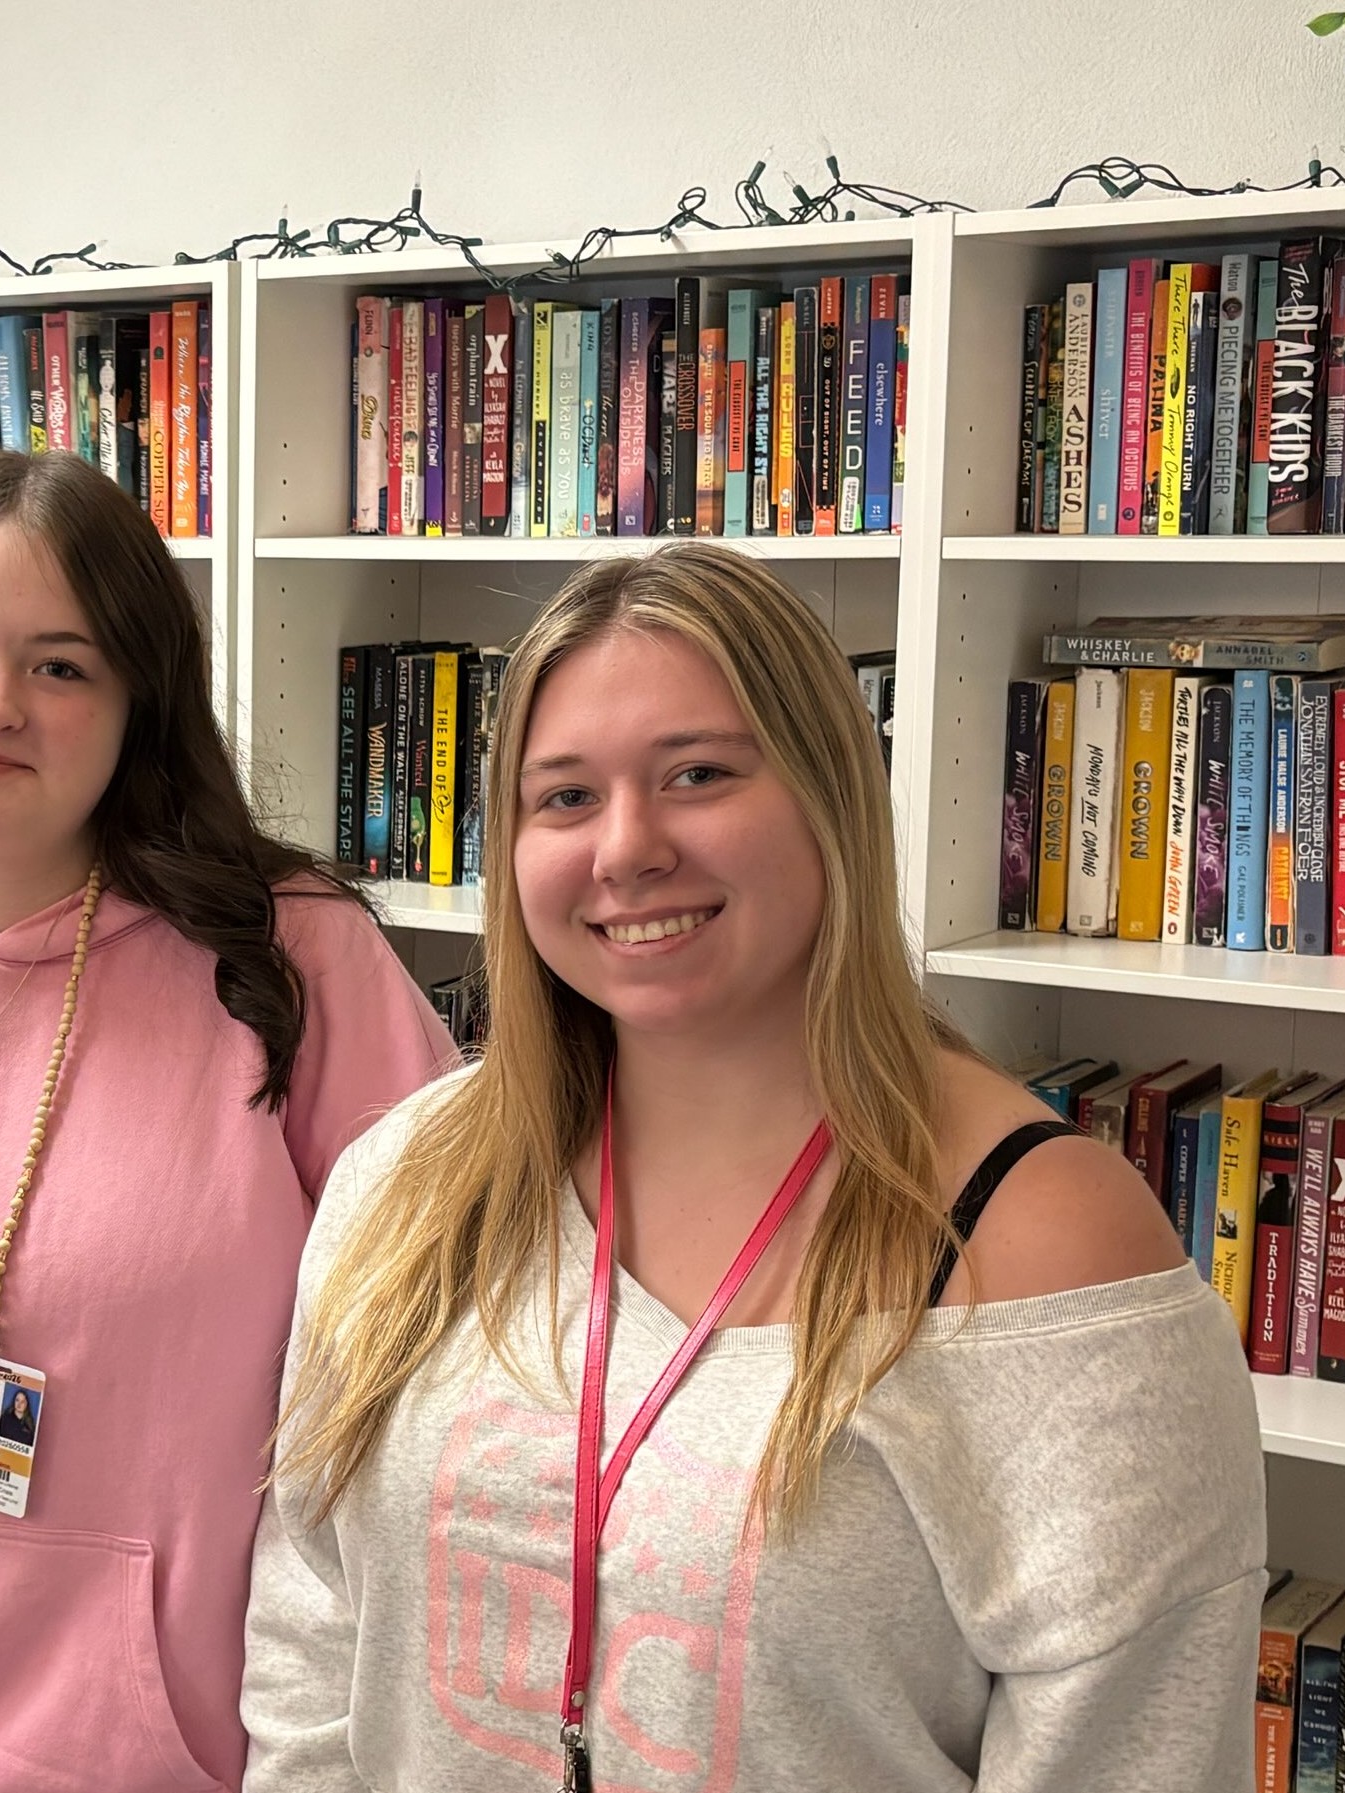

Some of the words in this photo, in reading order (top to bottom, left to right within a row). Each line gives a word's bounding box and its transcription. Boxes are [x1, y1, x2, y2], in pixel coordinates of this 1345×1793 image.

[1172, 276, 1188, 311] There
[1228, 262, 1242, 292] Watson
[1282, 263, 1310, 307] The
[1132, 312, 1145, 328] THE
[1171, 317, 1186, 354] There
[404, 336, 418, 362] BAD
[452, 324, 461, 368] tuesdays
[469, 334, 480, 376] orphan
[484, 334, 509, 375] X
[1066, 314, 1079, 398] ANDERSON
[1129, 333, 1145, 377] BENEFITS
[1220, 326, 1239, 389] PIECING
[1272, 305, 1319, 399] BLACK
[51, 355, 61, 386] OTHER
[451, 371, 461, 392] with
[560, 371, 573, 388] as
[629, 359, 640, 382] THE
[757, 357, 770, 381] ALL
[1128, 381, 1142, 392] OF
[178, 383, 191, 400] the
[404, 366, 418, 415] FEELING
[469, 379, 479, 407] train
[677, 362, 696, 430] CROSSOVER
[756, 386, 769, 411] THE
[846, 340, 865, 470] FEED
[875, 363, 888, 426] elsewhere
[1186, 385, 1196, 403] NO
[1218, 394, 1235, 416] ME
[1328, 395, 1345, 410] THE
[172, 402, 191, 444] Rhythm
[451, 396, 461, 429] Morrie
[620, 387, 635, 447] OUTSIDE
[632, 381, 646, 466] DARKNESS
[1024, 421, 1031, 434] OF
[1099, 388, 1117, 440] shiver
[1127, 397, 1142, 426] BEING
[1162, 406, 1182, 455] Tommy
[1185, 408, 1196, 446] RIGHT
[755, 414, 769, 453] RIGHT
[1126, 430, 1140, 443] AN
[1268, 413, 1312, 483] KIDS
[1326, 412, 1345, 450] DARKEST
[154, 432, 165, 495] COPPER
[177, 447, 190, 477] Takes
[405, 454, 415, 474] JEFF
[558, 447, 571, 464] as
[619, 449, 630, 475] US
[1022, 440, 1034, 486] DREAMS
[1062, 405, 1085, 514] ASHES
[1123, 447, 1140, 491] OCTOPUS
[1183, 449, 1194, 491] TURN
[1214, 417, 1234, 495] TOGETHER
[1324, 453, 1343, 477] HOUR
[1159, 460, 1179, 506] Orange
[1066, 639, 1132, 651] WHISKEY
[1080, 651, 1089, 661] &
[1092, 651, 1155, 663] CHARLIE
[1215, 645, 1273, 656] ANNABEL
[1245, 655, 1285, 665] SMITH
[398, 661, 410, 701] ALONE
[341, 687, 355, 719] SEE
[398, 704, 407, 721] ON
[437, 709, 448, 734] THE
[1177, 687, 1191, 728] TURTLES
[1239, 700, 1254, 725] THE
[397, 725, 406, 747] THE
[1175, 730, 1190, 752] ALL
[1300, 696, 1315, 766] JONATHAN
[1314, 695, 1328, 753] EXTREMELY
[340, 727, 355, 760] ALL
[436, 741, 447, 767] END
[1238, 731, 1254, 783] MEMORY
[1278, 729, 1289, 758] LAURIE
[340, 764, 353, 799] THE
[367, 722, 387, 818] WANDMAKER
[396, 751, 405, 782] WALL
[414, 739, 427, 787] Wanted
[1175, 752, 1188, 775] THE
[1277, 761, 1289, 787] HALSE
[1313, 755, 1326, 786] LOUD
[435, 774, 446, 791] OF
[1173, 776, 1188, 804] WAY
[1207, 759, 1225, 809] WHITE
[1237, 786, 1253, 801] OF
[1298, 767, 1313, 825] SAFRAN
[1044, 765, 1066, 862] GROWN
[1082, 799, 1099, 827] NOT
[1129, 761, 1153, 860] GROWN
[1171, 804, 1185, 837] DOWN
[1276, 790, 1288, 834] ANDERSON
[1312, 795, 1326, 848] INCREDIBLY
[339, 805, 352, 861] STARS
[1009, 806, 1029, 866] SMOKE
[1203, 818, 1225, 878] SMOKE
[1080, 830, 1099, 878] COMING
[1170, 841, 1186, 874] JOHN
[1272, 846, 1289, 900] CATALYST
[1297, 827, 1312, 882] FOER
[1311, 848, 1325, 883] CLOSE
[1167, 876, 1183, 917] GREEN
[1225, 1116, 1240, 1147] Safe
[1221, 1152, 1239, 1197] Haven
[1304, 1148, 1324, 1191] WE'LL
[1300, 1196, 1321, 1257] ALWAYS
[1263, 1232, 1279, 1342] TRADITION
[1298, 1258, 1318, 1300] HAVE
[1294, 1296, 1316, 1356] Summer
